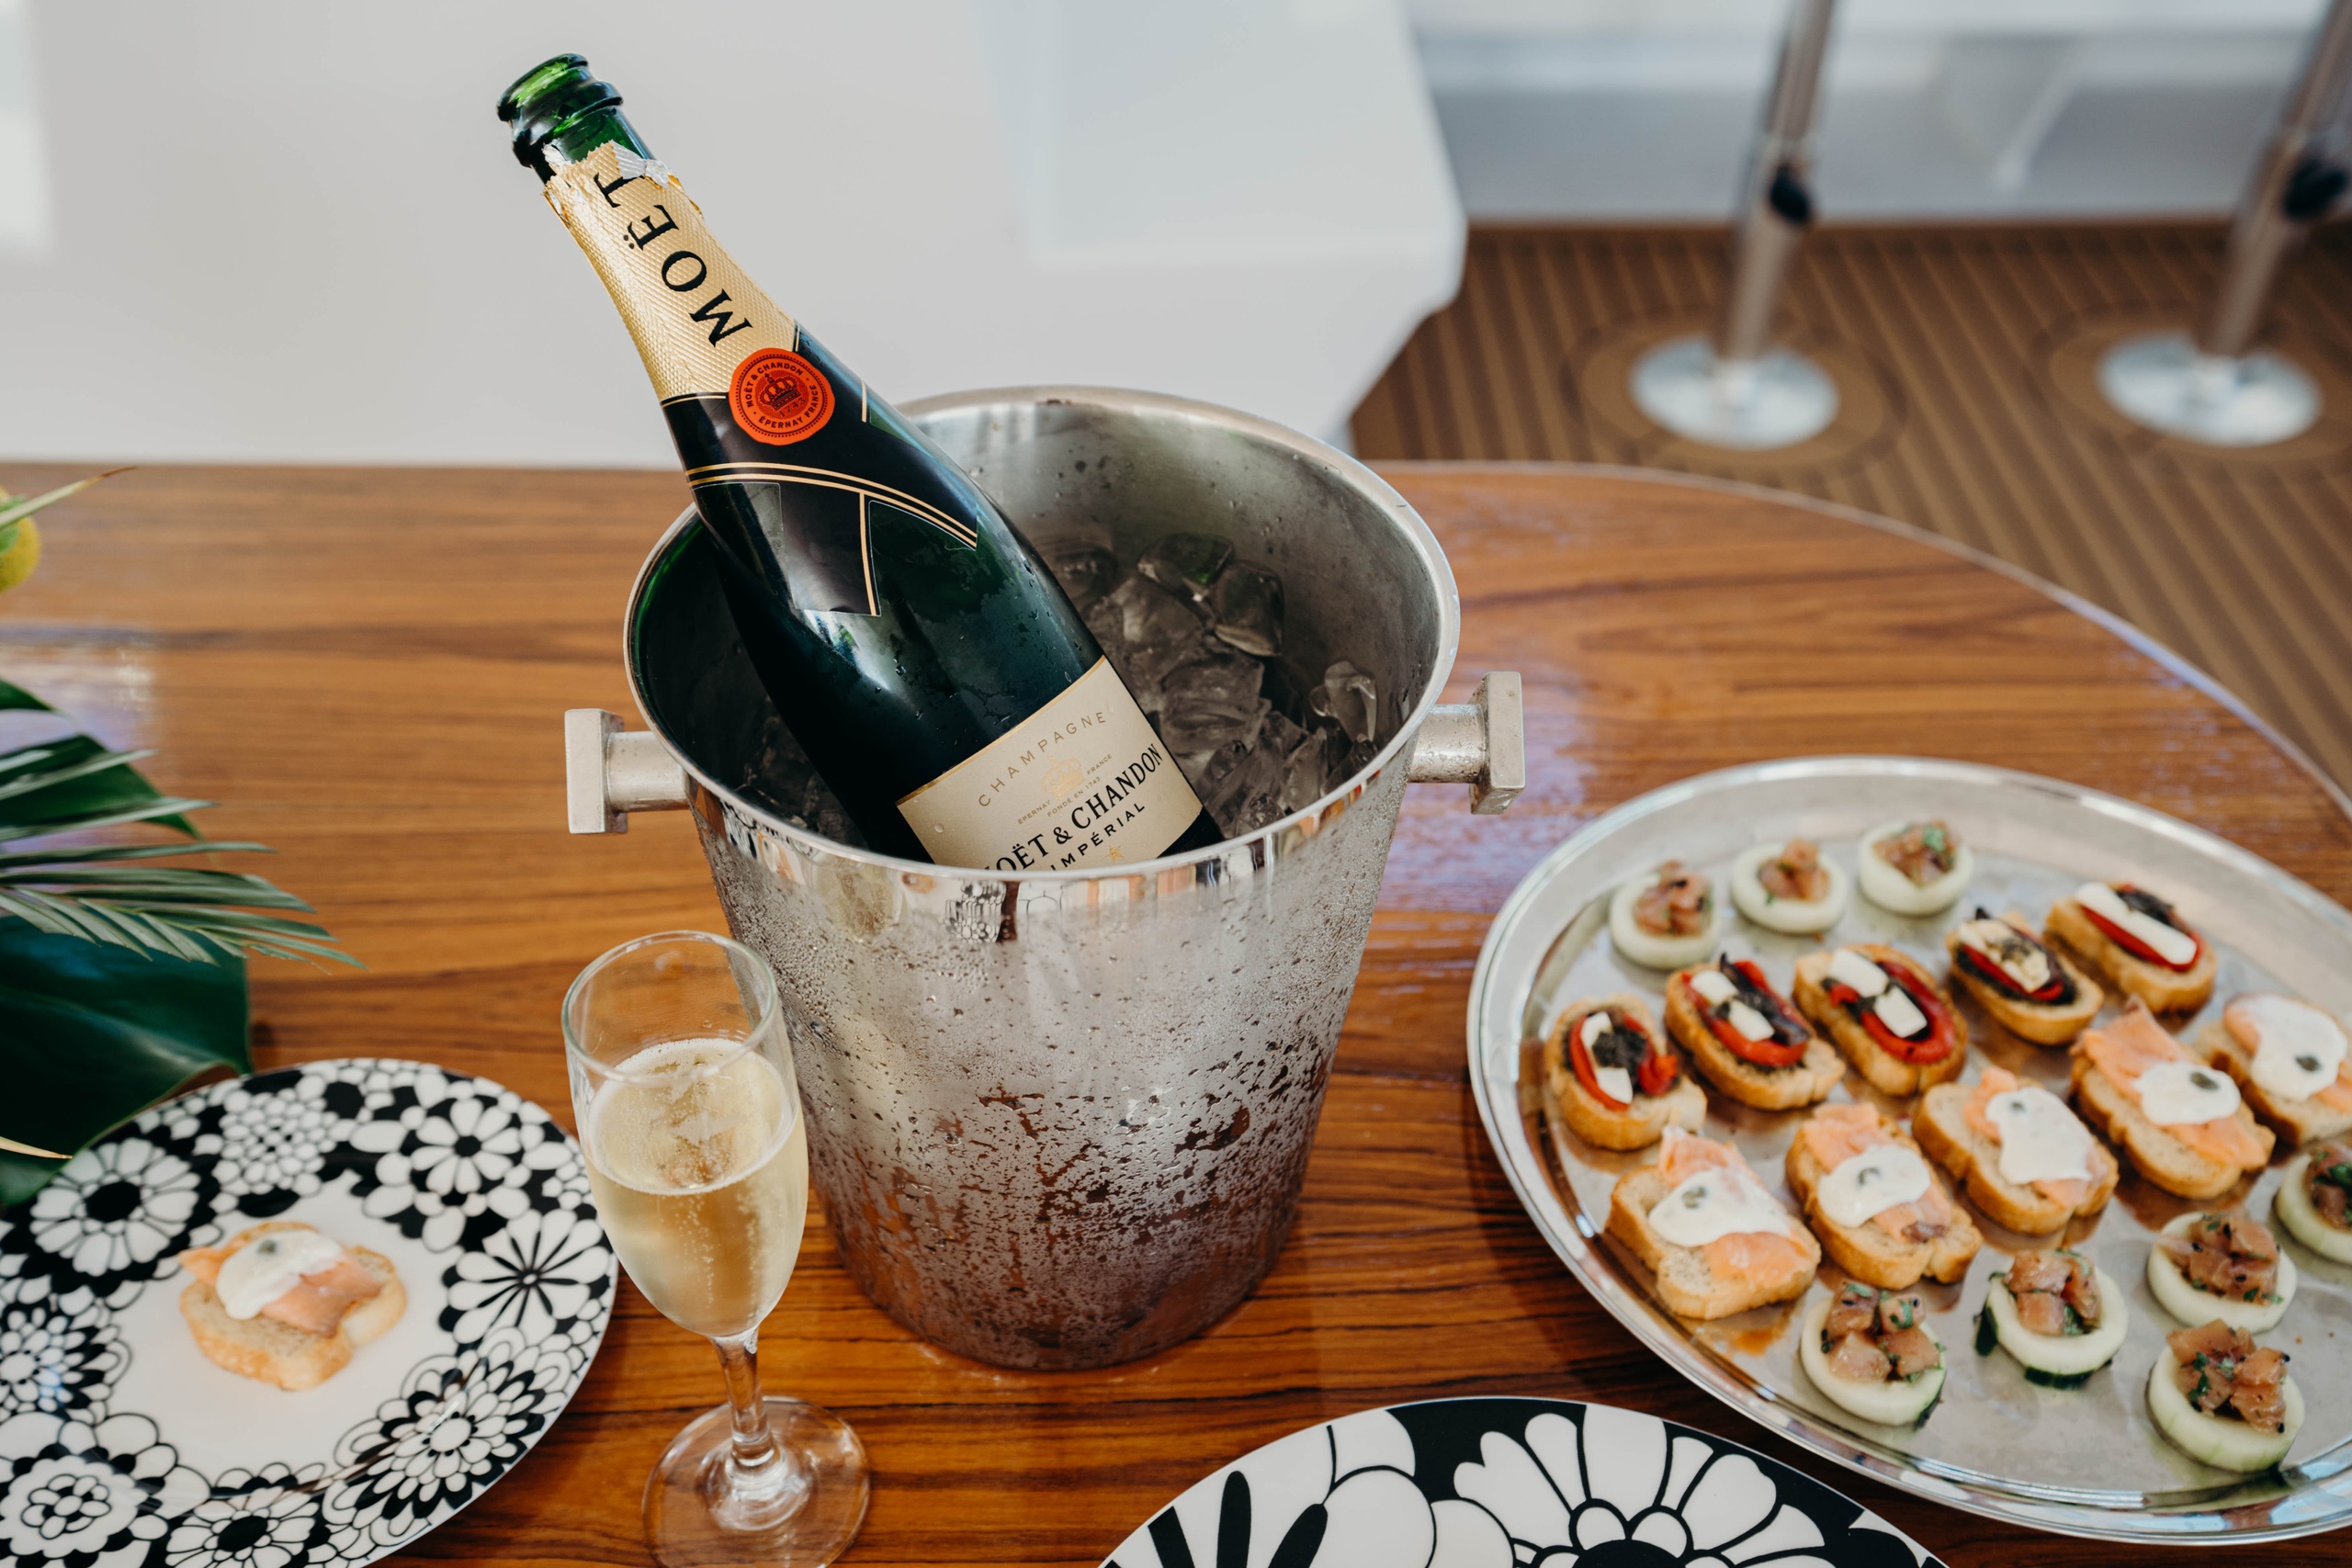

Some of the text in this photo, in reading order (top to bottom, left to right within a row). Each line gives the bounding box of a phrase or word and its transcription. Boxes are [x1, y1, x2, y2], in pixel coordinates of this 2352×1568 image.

[591, 172, 753, 347] MOËT
[743, 381, 754, 408] MOËT
[757, 362, 804, 376] CHANDON
[758, 385, 819, 428] ÉPERNAY FRANCE
[778, 397, 807, 417] 1743
[978, 711, 1106, 807] CHAMPAGNE
[1087, 752, 1113, 775] FRANCE
[984, 743, 1163, 871] OËT & CHANDON
[1047, 776, 1101, 818] FONDÉ EN 1743
